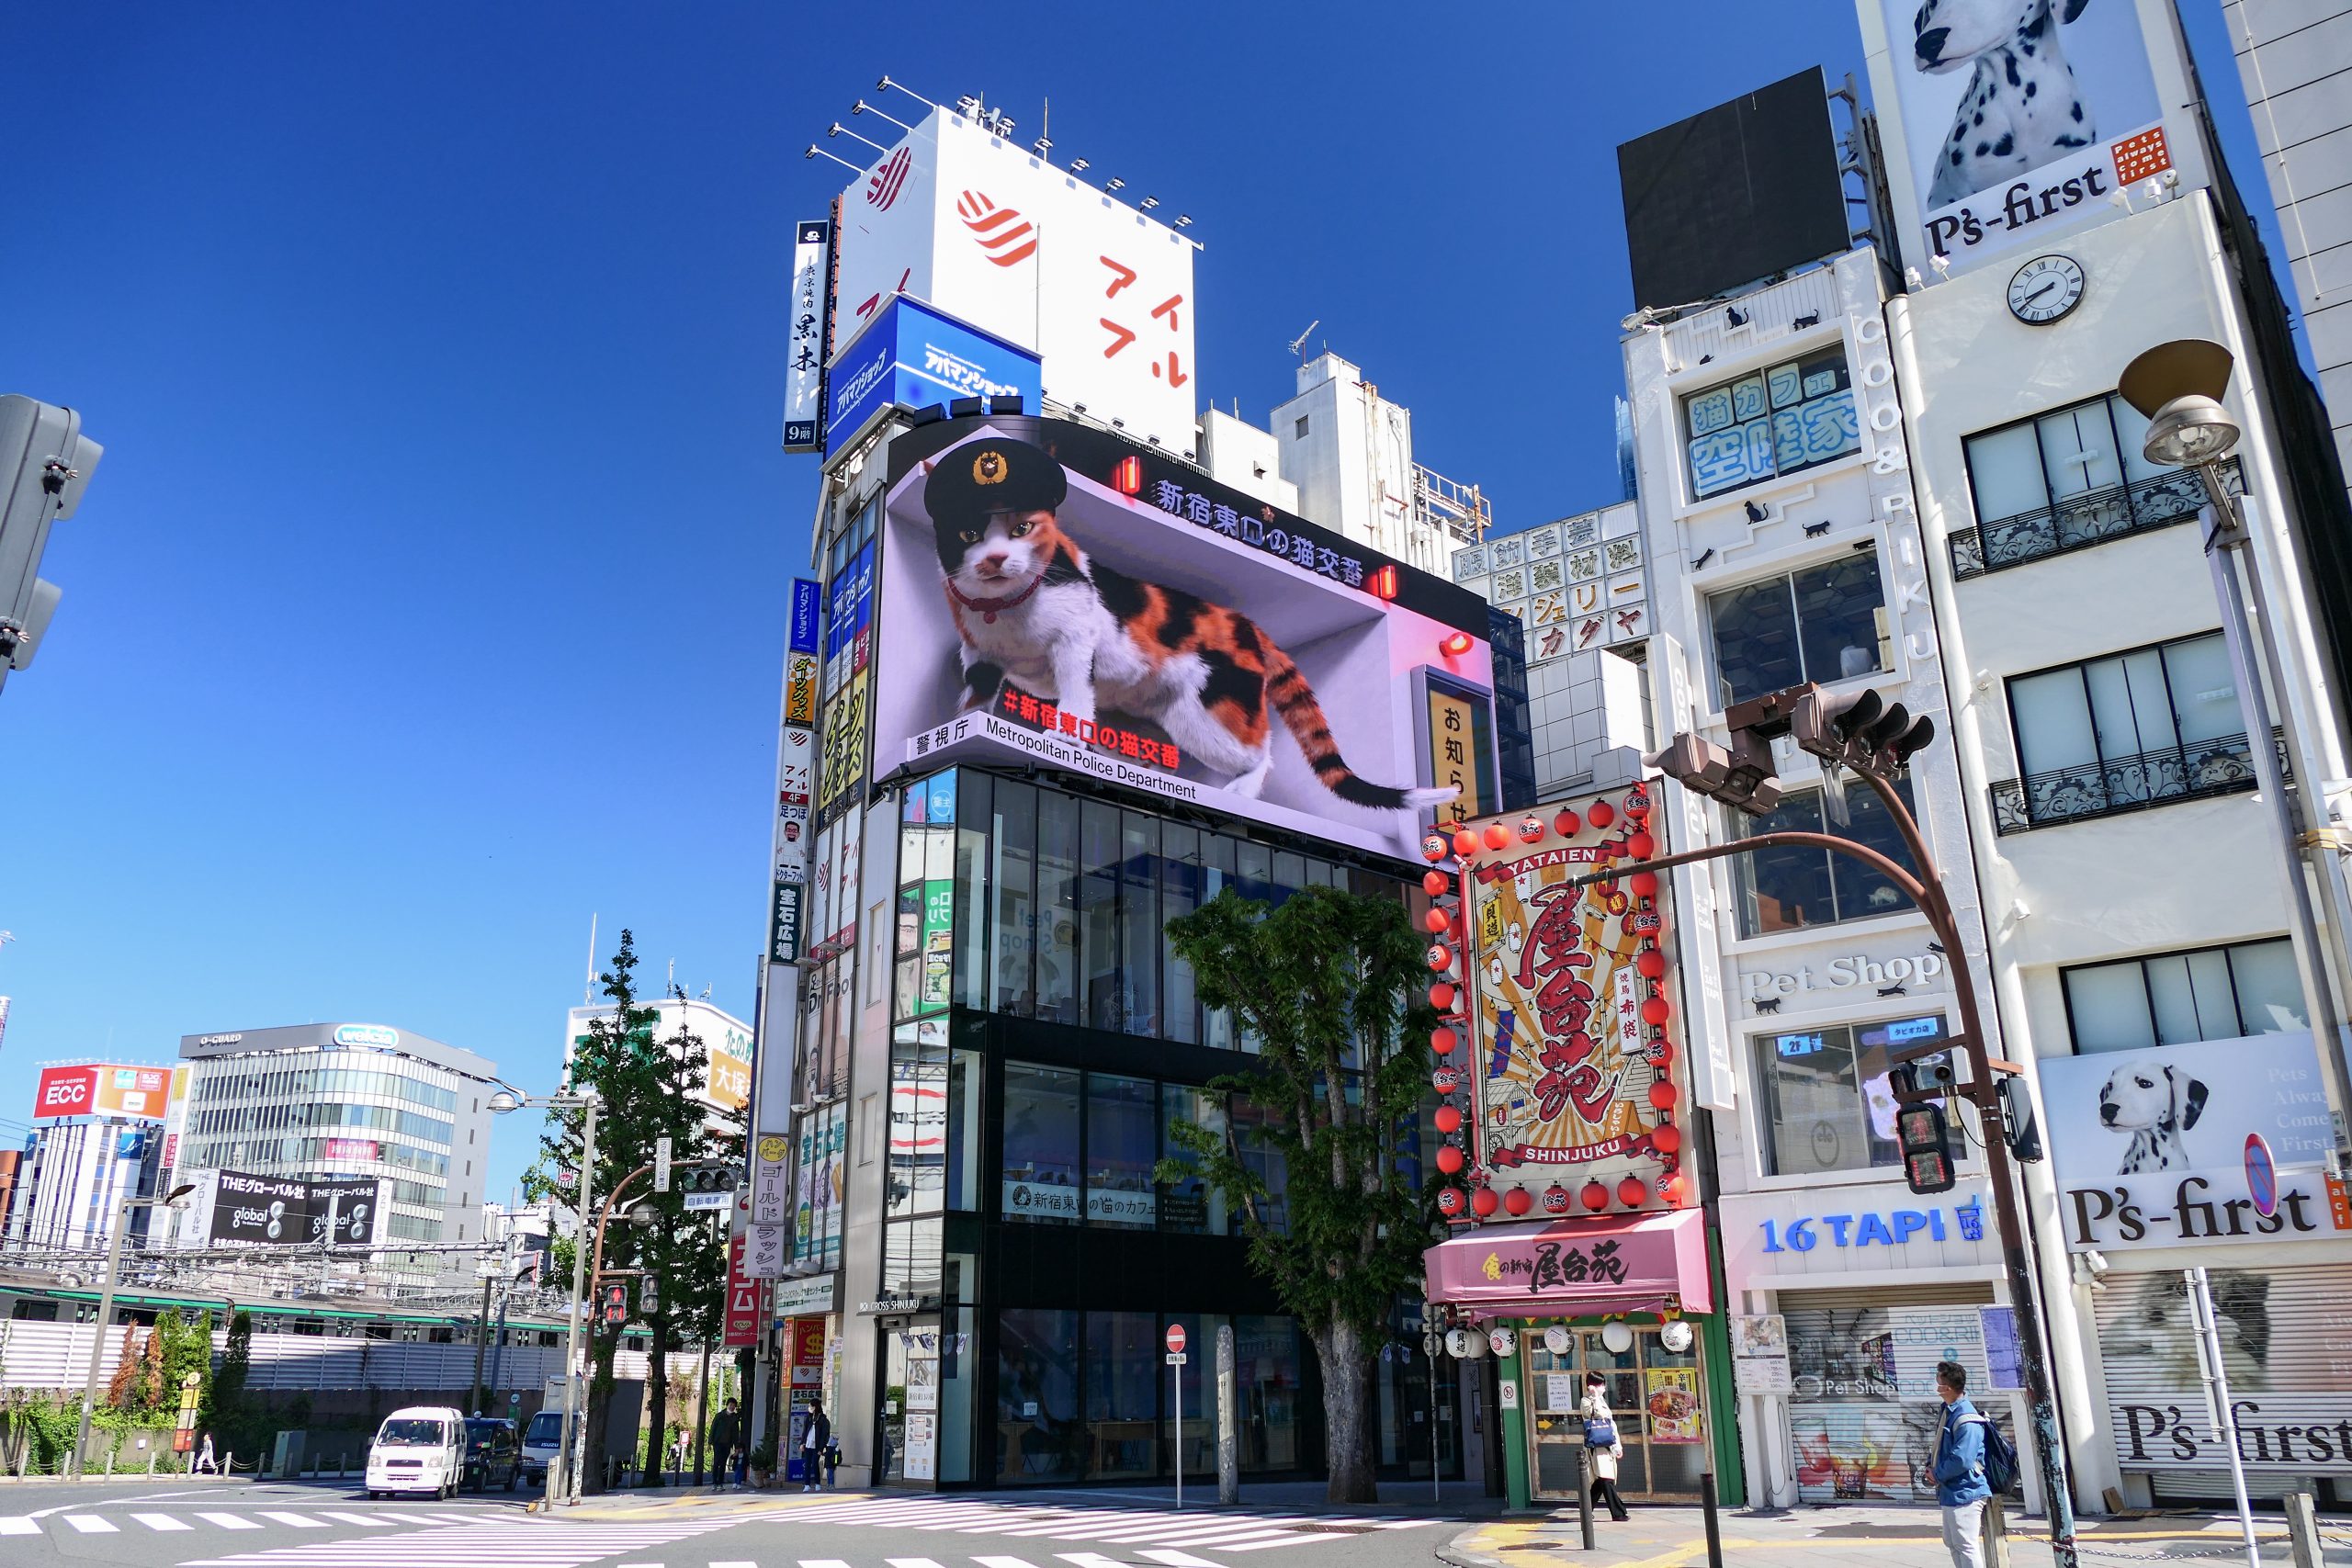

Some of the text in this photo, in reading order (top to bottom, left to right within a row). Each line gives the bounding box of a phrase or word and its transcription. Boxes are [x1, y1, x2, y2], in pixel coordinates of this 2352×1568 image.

[2115, 130, 2161, 154] Pets
[2116, 140, 2163, 164] always
[2119, 149, 2165, 172] come
[2120, 157, 2167, 182] first
[1925, 166, 2107, 257] P's-first
[837, 348, 887, 414] アパマンショップ
[924, 350, 1019, 397] アパマンショップ
[1692, 368, 1834, 432] 猫カフェ
[1693, 393, 1862, 491] 空陸家
[1157, 479, 1363, 588] 新宿東口の猫交番
[1458, 518, 1596, 579] 服飾手芸
[1497, 538, 1639, 600] 洋装材料
[792, 658, 810, 718] ダーツグッズ
[916, 719, 969, 756] 警視庁
[986, 717, 1197, 800] Metropolitan Police Department
[1444, 707, 1467, 823] お知らせ
[788, 794, 801, 803] 4F
[780, 806, 808, 820] 足つぼ
[1508, 849, 1597, 877] YATAIEN
[775, 889, 797, 962] 宝石広場
[1739, 953, 1942, 1001] Pet Shop
[1894, 1025, 1929, 1036] タピオカ店
[1789, 1041, 1802, 1053] 2F
[2267, 1067, 2308, 1083] Pets
[46, 1084, 86, 1105] ECC
[2274, 1089, 2328, 1106] Alwa
[2276, 1113, 2330, 1129] Come
[1524, 1139, 1622, 1165] SHINJUKU
[220, 1175, 306, 1200] THEグローバル社
[311, 1186, 375, 1198] THEグローバル社
[687, 1196, 730, 1206] 自転車専用
[2066, 1177, 2316, 1245] P's-first
[232, 1206, 268, 1229] global
[755, 1165, 783, 1277] ゴールドラッシュ
[1758, 1208, 1947, 1253] 16 TAPI
[870, 1298, 919, 1312] CROSS SHINJUKU
[799, 1324, 825, 1336] ハンバー
[1826, 1379, 1897, 1398] Pet Shop
